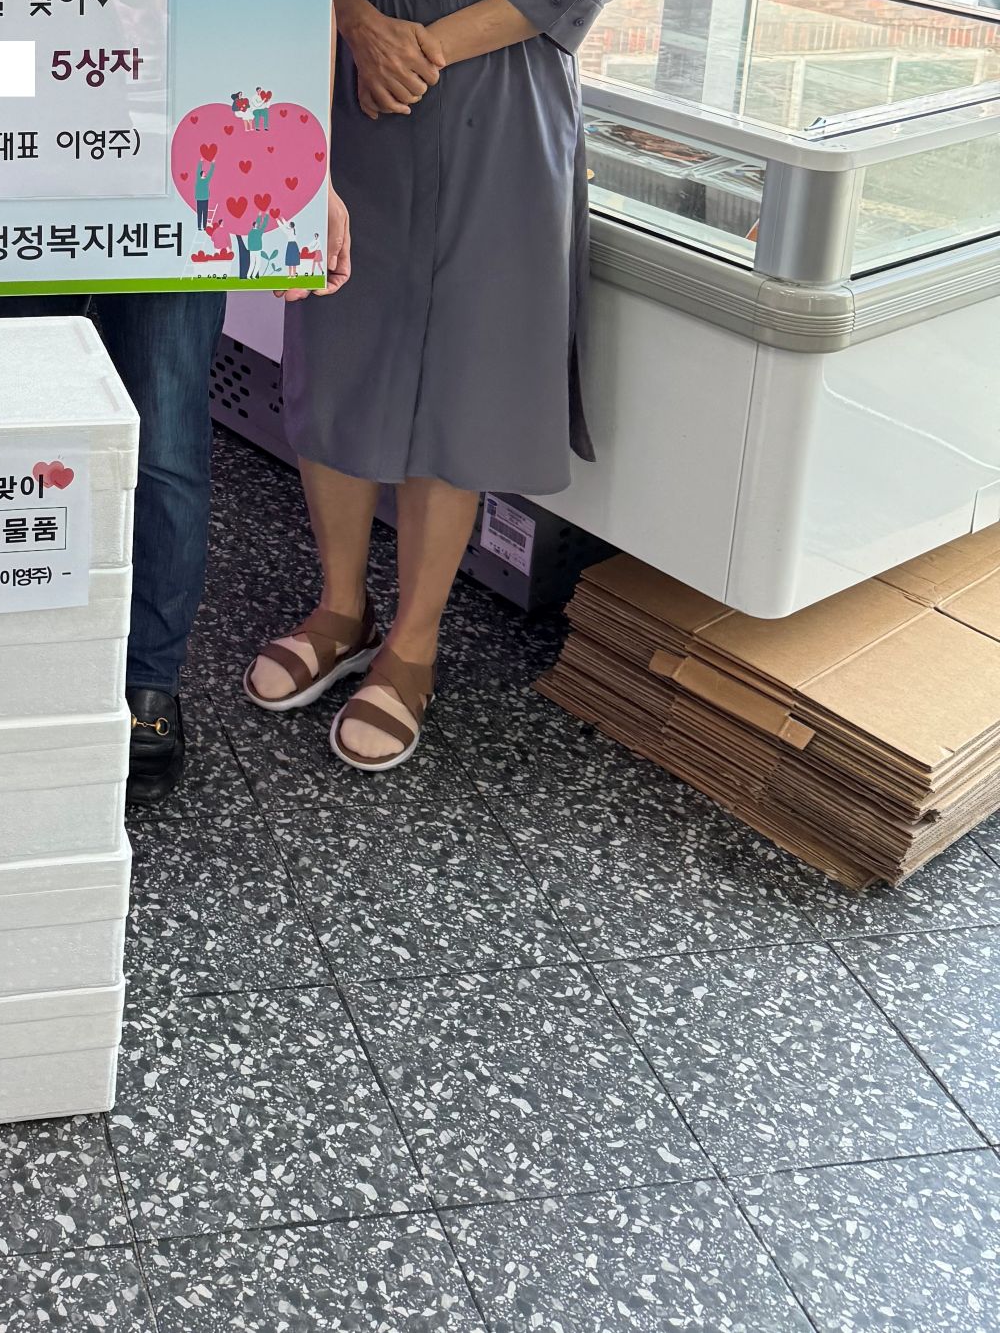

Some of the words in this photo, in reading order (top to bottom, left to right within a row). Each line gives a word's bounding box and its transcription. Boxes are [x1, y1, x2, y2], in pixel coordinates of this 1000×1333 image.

[50, 48, 145, 88] 5상자
[55, 129, 143, 162] 이영주)
[0, 565, 53, 588] 이영주)
